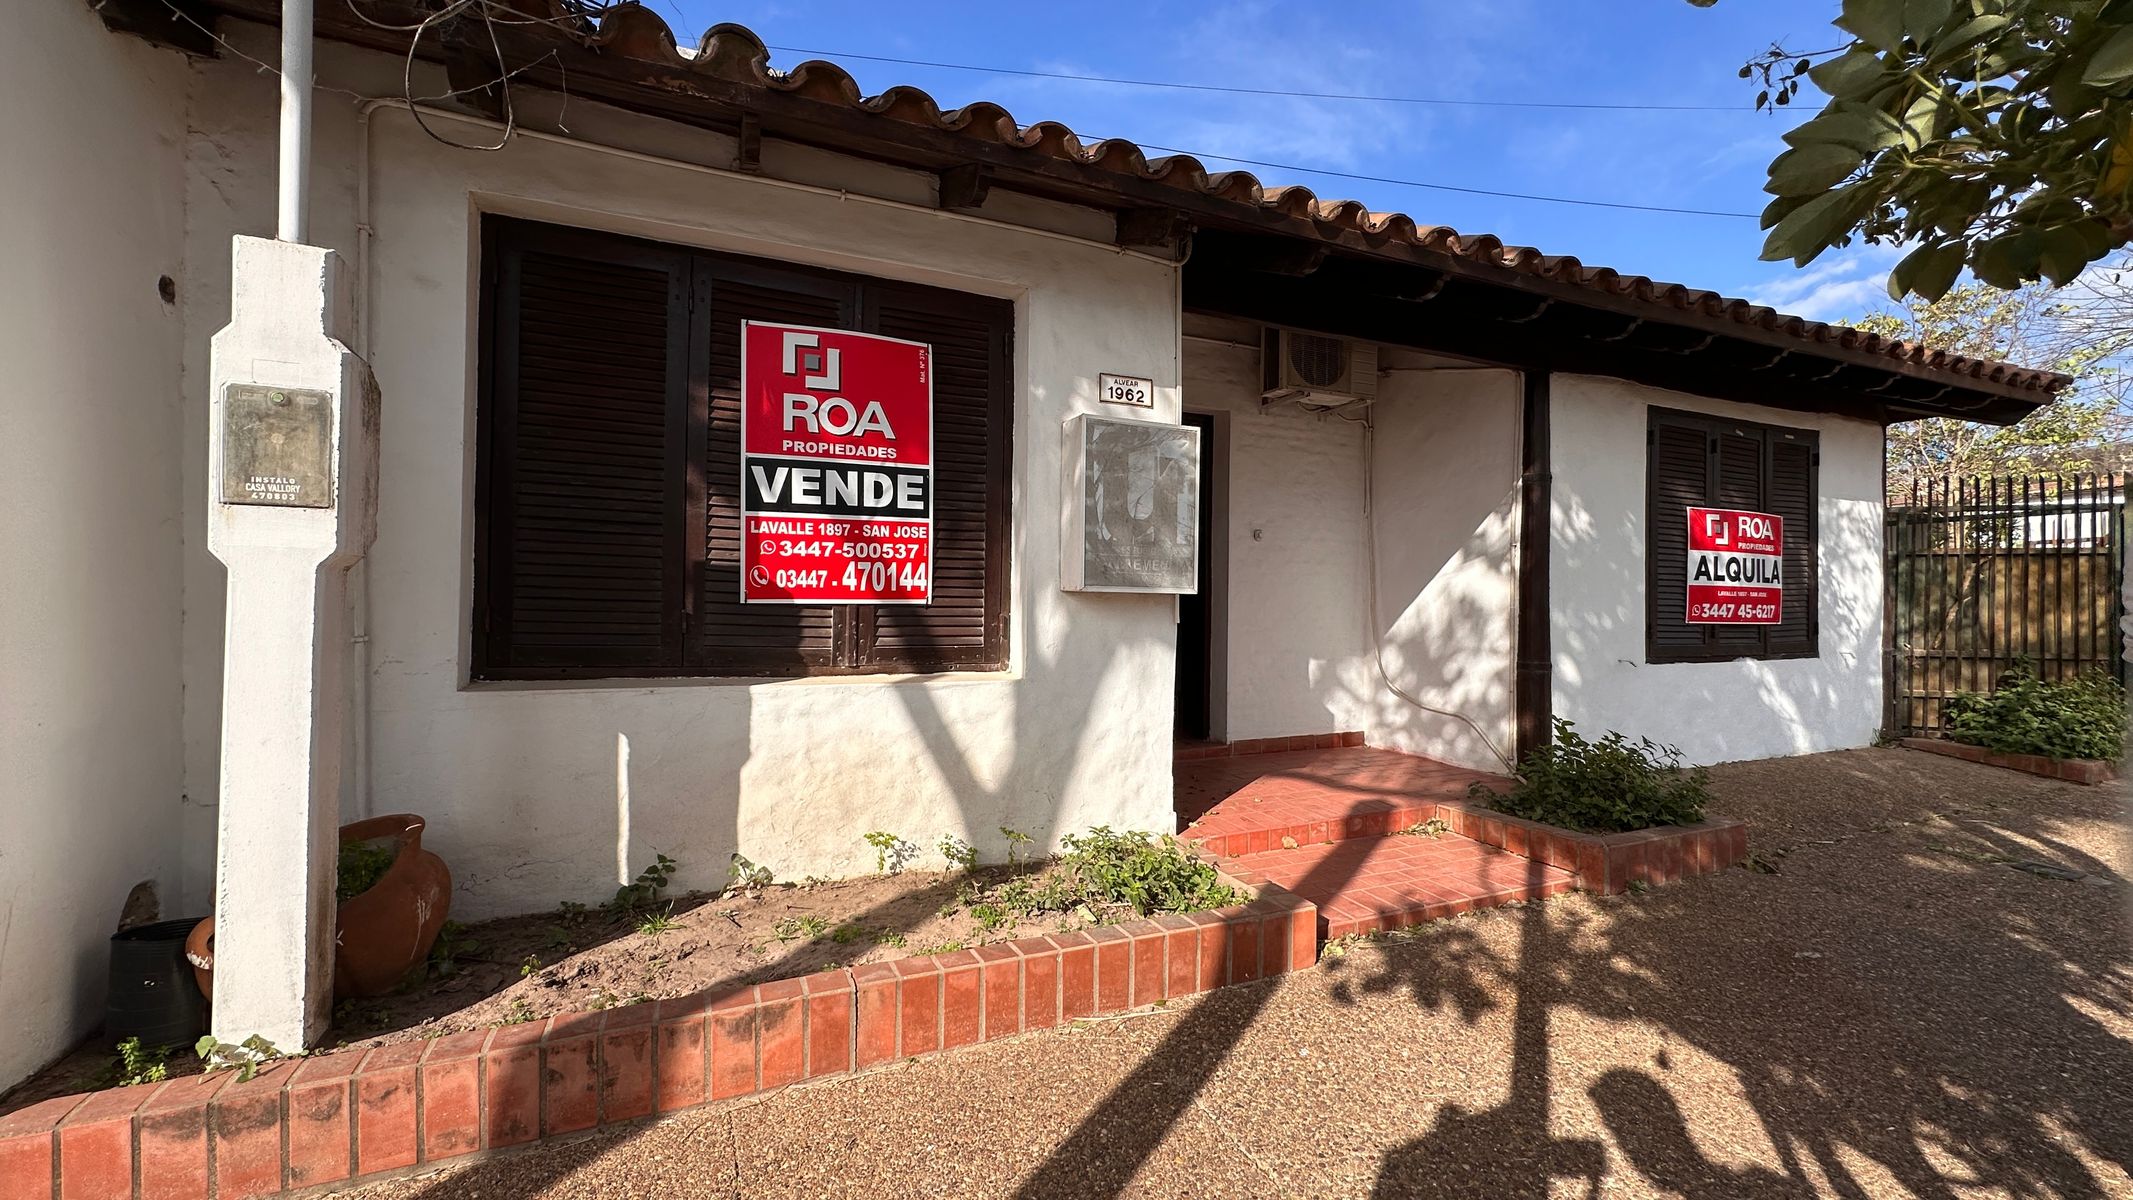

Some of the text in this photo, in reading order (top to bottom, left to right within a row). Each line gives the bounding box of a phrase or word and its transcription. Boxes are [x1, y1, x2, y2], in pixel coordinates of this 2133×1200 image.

[1114, 379, 1139, 387] ALVEAR
[1107, 386, 1145, 403] 1962
[783, 392, 896, 440] ROA
[782, 439, 897, 459] PROPIEDADES
[245, 482, 301, 493] CASA VALLORY
[251, 476, 295, 484] INSTALO
[751, 465, 925, 510] VENDE
[251, 492, 296, 501] 470803
[750, 520, 814, 536] LAVALLE
[818, 522, 851, 537] 1897
[862, 524, 890, 538] SAN
[893, 525, 927, 539] JOSE
[1738, 516, 1775, 541] ROA
[779, 540, 920, 560] 3447-500537
[1738, 543, 1774, 551] PROPIEDADES
[776, 569, 828, 588] 03447
[842, 561, 928, 592] 470144
[1693, 555, 1780, 584] ALQUILA
[1701, 603, 1775, 619] 3447 45-6217
